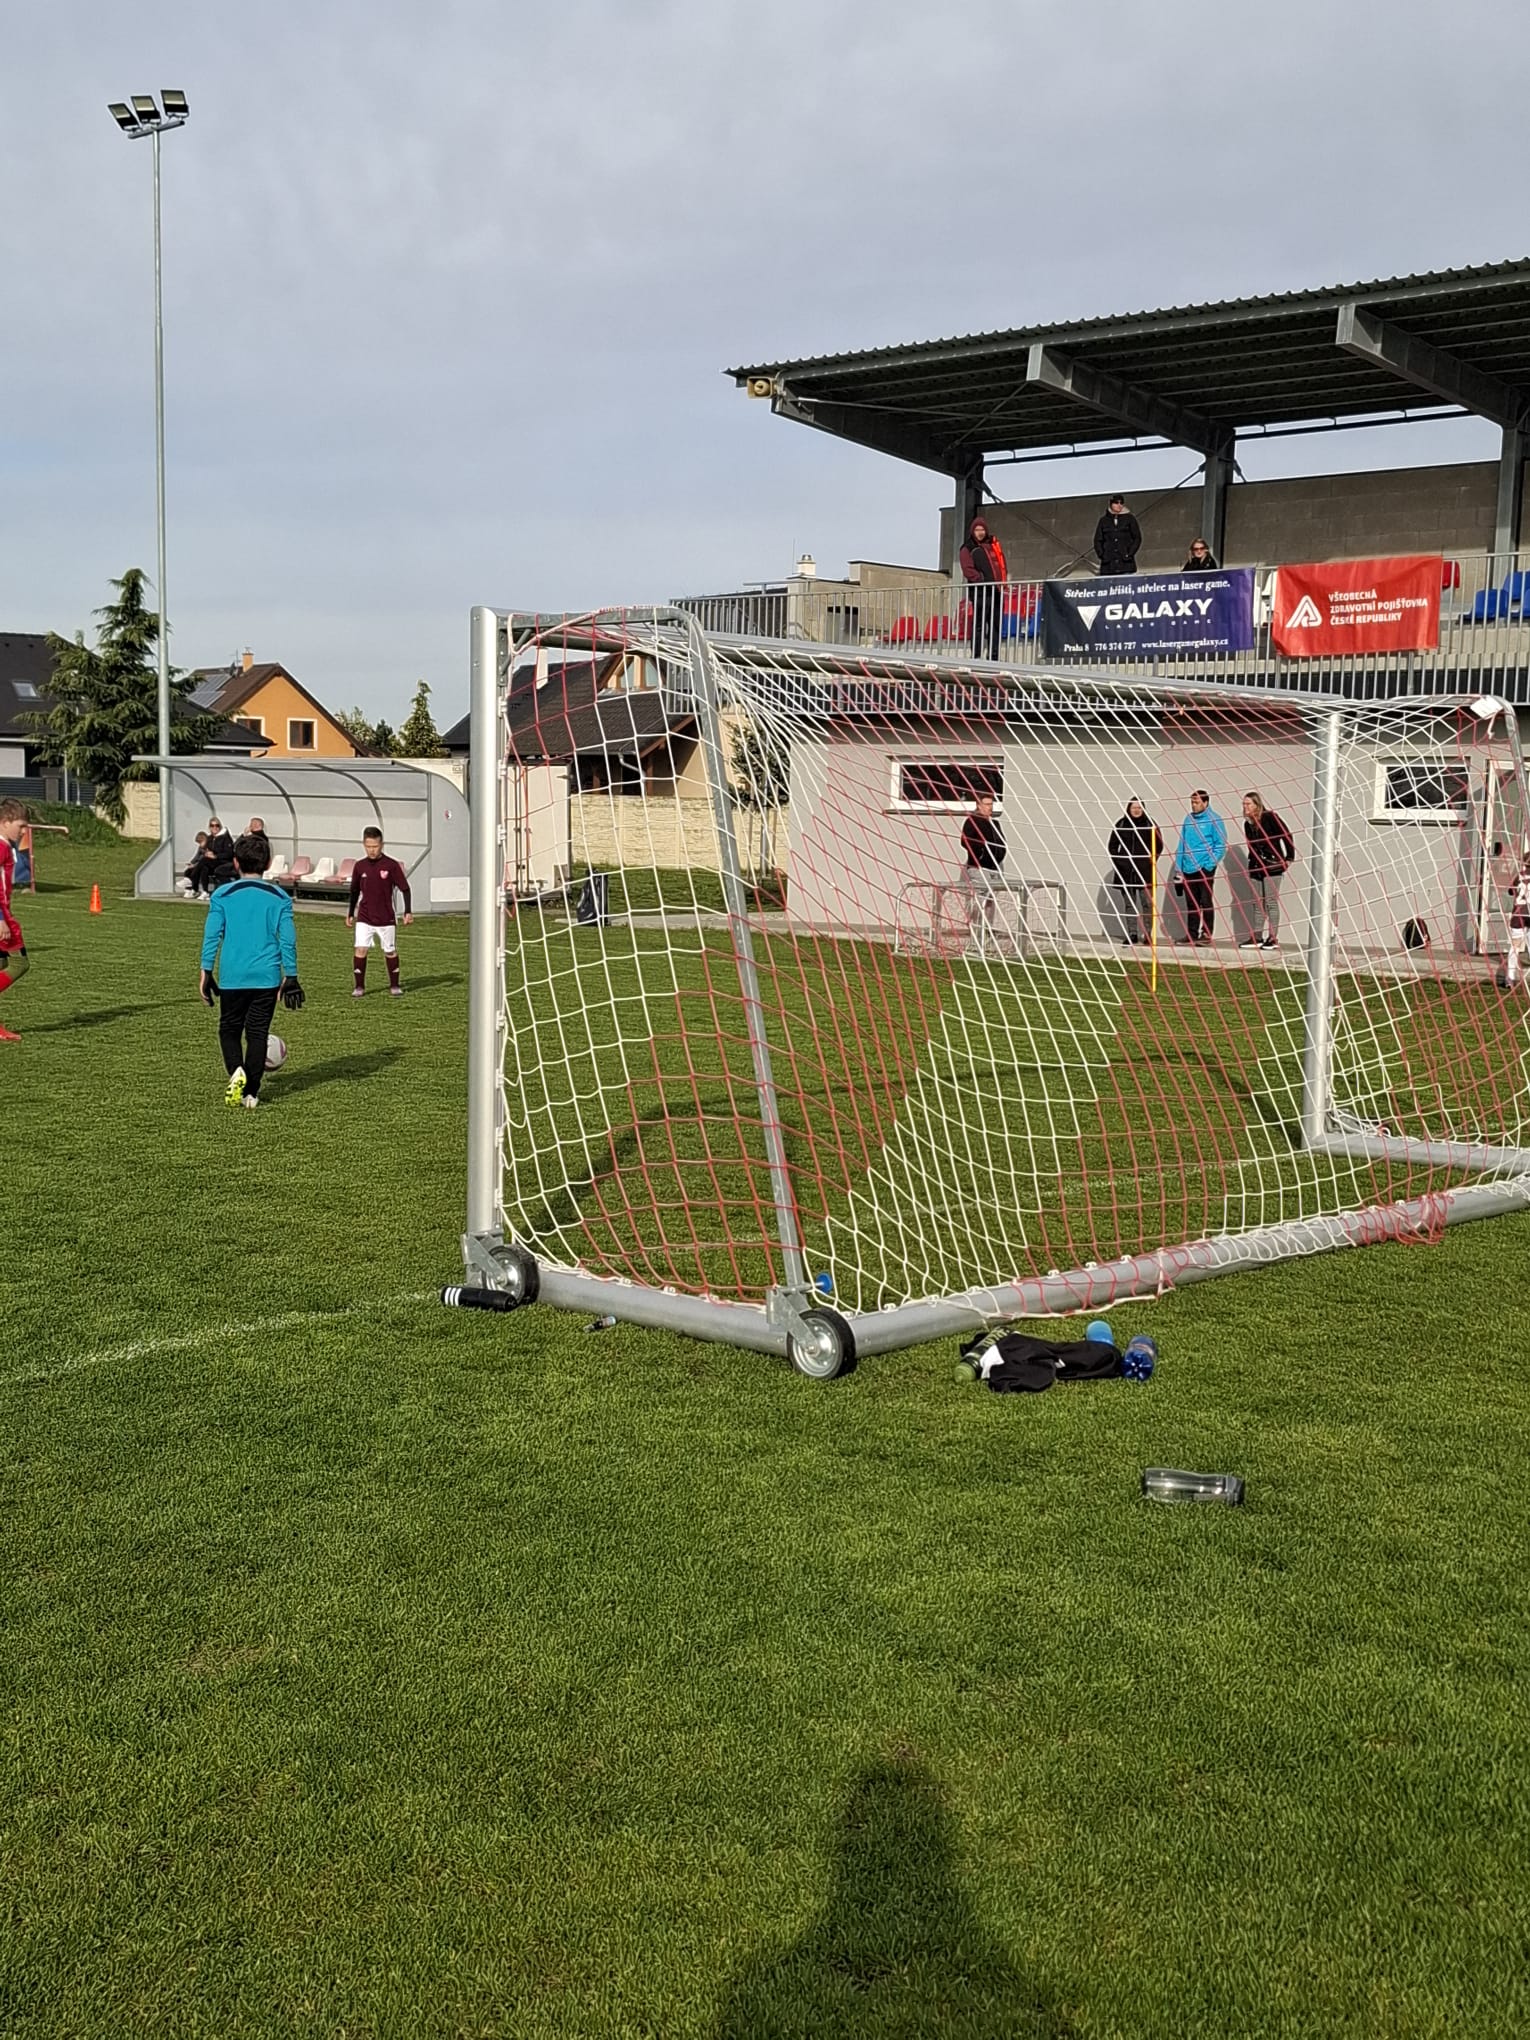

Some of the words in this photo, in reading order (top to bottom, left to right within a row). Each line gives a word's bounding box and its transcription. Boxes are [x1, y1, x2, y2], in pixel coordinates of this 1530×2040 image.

[1064, 588, 1096, 598] Střelec
[1097, 589, 1108, 597] na
[1137, 582, 1166, 592] střelec
[1168, 583, 1179, 591] na
[1181, 580, 1204, 590] laser
[1205, 580, 1231, 592] game.
[1328, 588, 1377, 601] VŠEOBECNÁ
[1105, 598, 1213, 620] GALAXY
[1330, 601, 1376, 613] ZDRAVOTNÍ
[1377, 597, 1428, 611] POJIŠŤOVNA
[1330, 613, 1354, 625] ČESKÉ
[1355, 612, 1402, 624] REPUBLIKY
[1064, 643, 1083, 652] Praha
